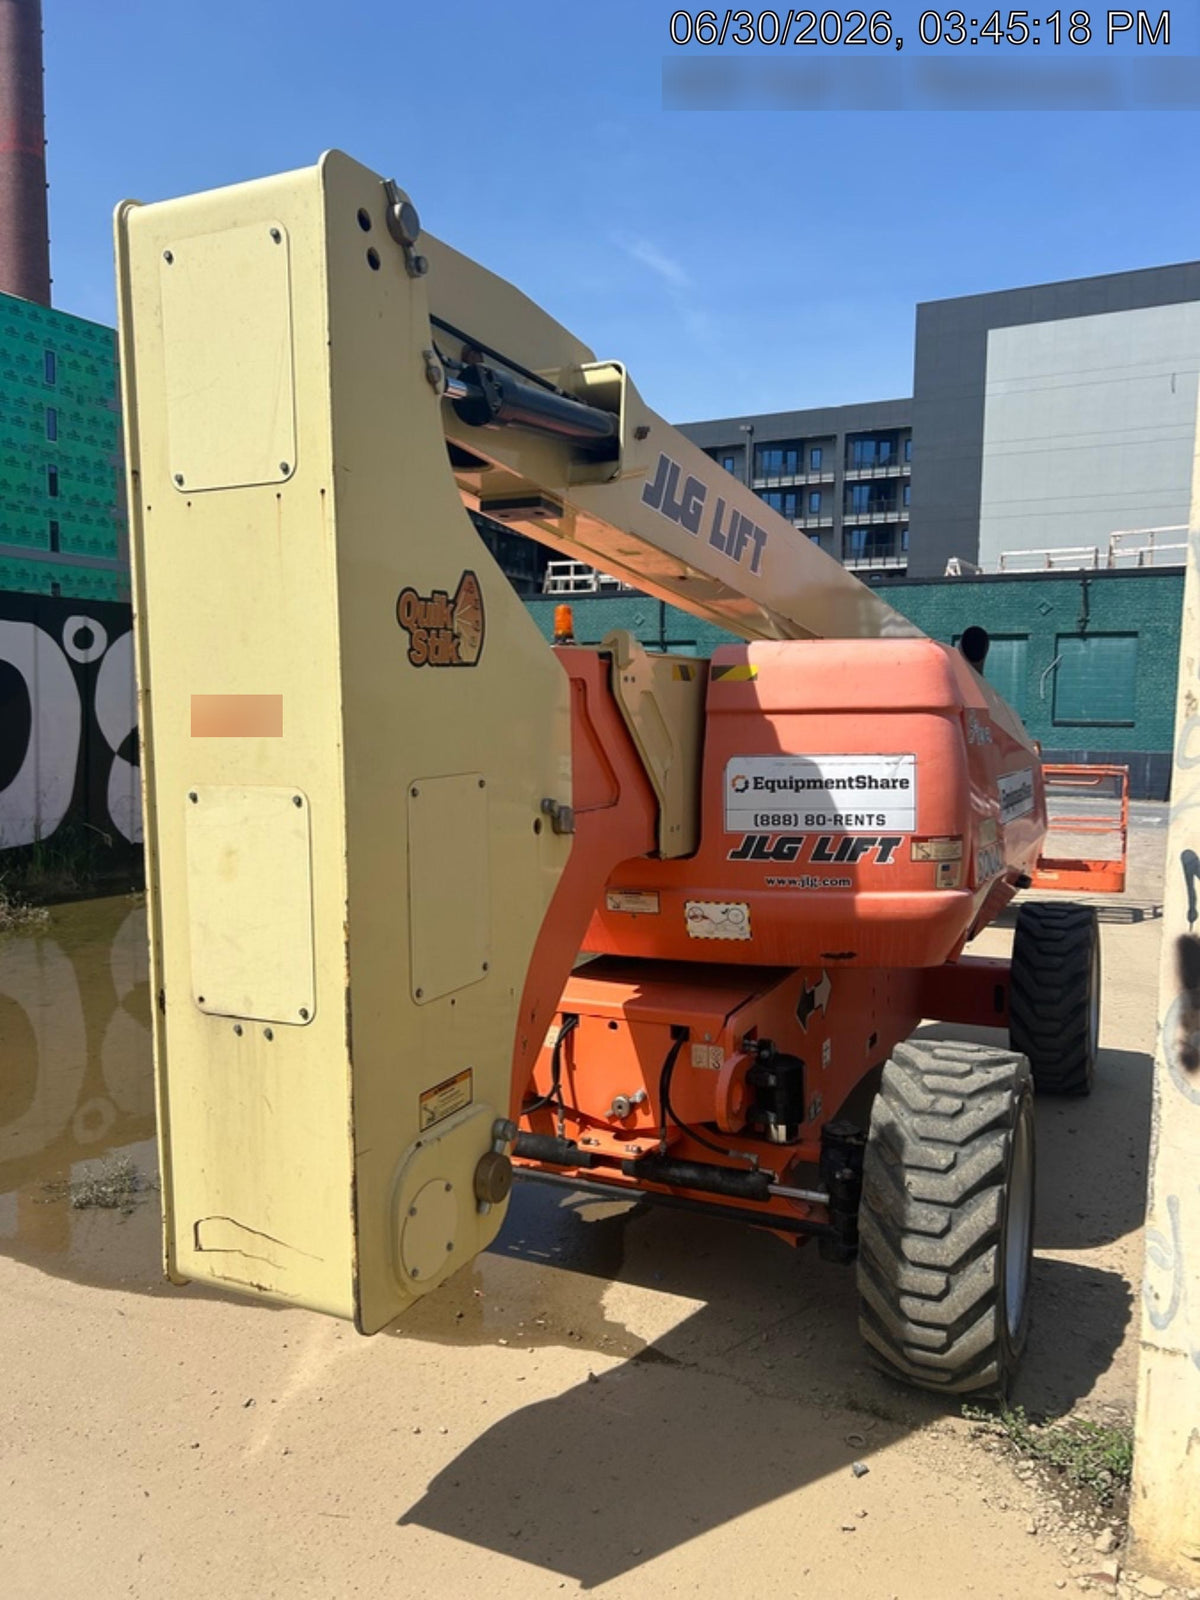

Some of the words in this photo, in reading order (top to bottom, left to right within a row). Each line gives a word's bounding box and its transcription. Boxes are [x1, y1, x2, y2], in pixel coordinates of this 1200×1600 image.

[641, 451, 709, 538] JLG
[708, 497, 768, 578] LIFT
[398, 590, 455, 631] Quik
[408, 628, 461, 665] Stik
[752, 775, 910, 793] EquipmentShare
[754, 813, 799, 827] (888)
[804, 813, 886, 827] 80-RENTS
[727, 834, 806, 863] JLG
[809, 835, 904, 864] LIFT
[765, 874, 851, 888] www.jlg.com
